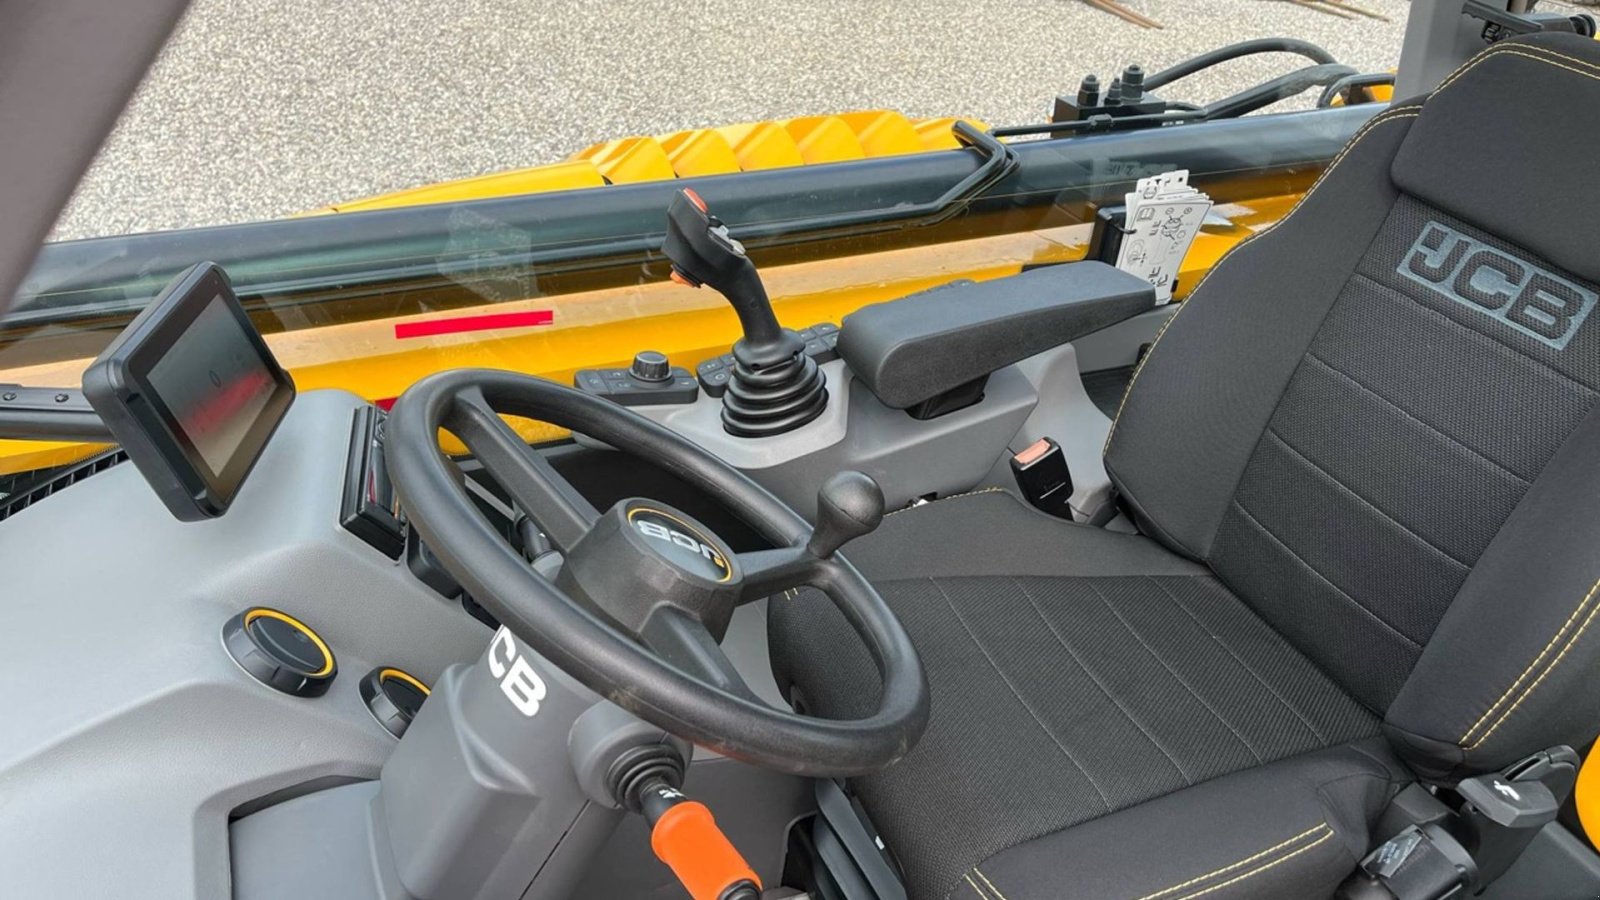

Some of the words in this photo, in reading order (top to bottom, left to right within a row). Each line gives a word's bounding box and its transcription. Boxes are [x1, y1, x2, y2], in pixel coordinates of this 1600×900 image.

[1405, 224, 1587, 341] JCB
[637, 520, 725, 568] JCB
[488, 624, 546, 717] CB
